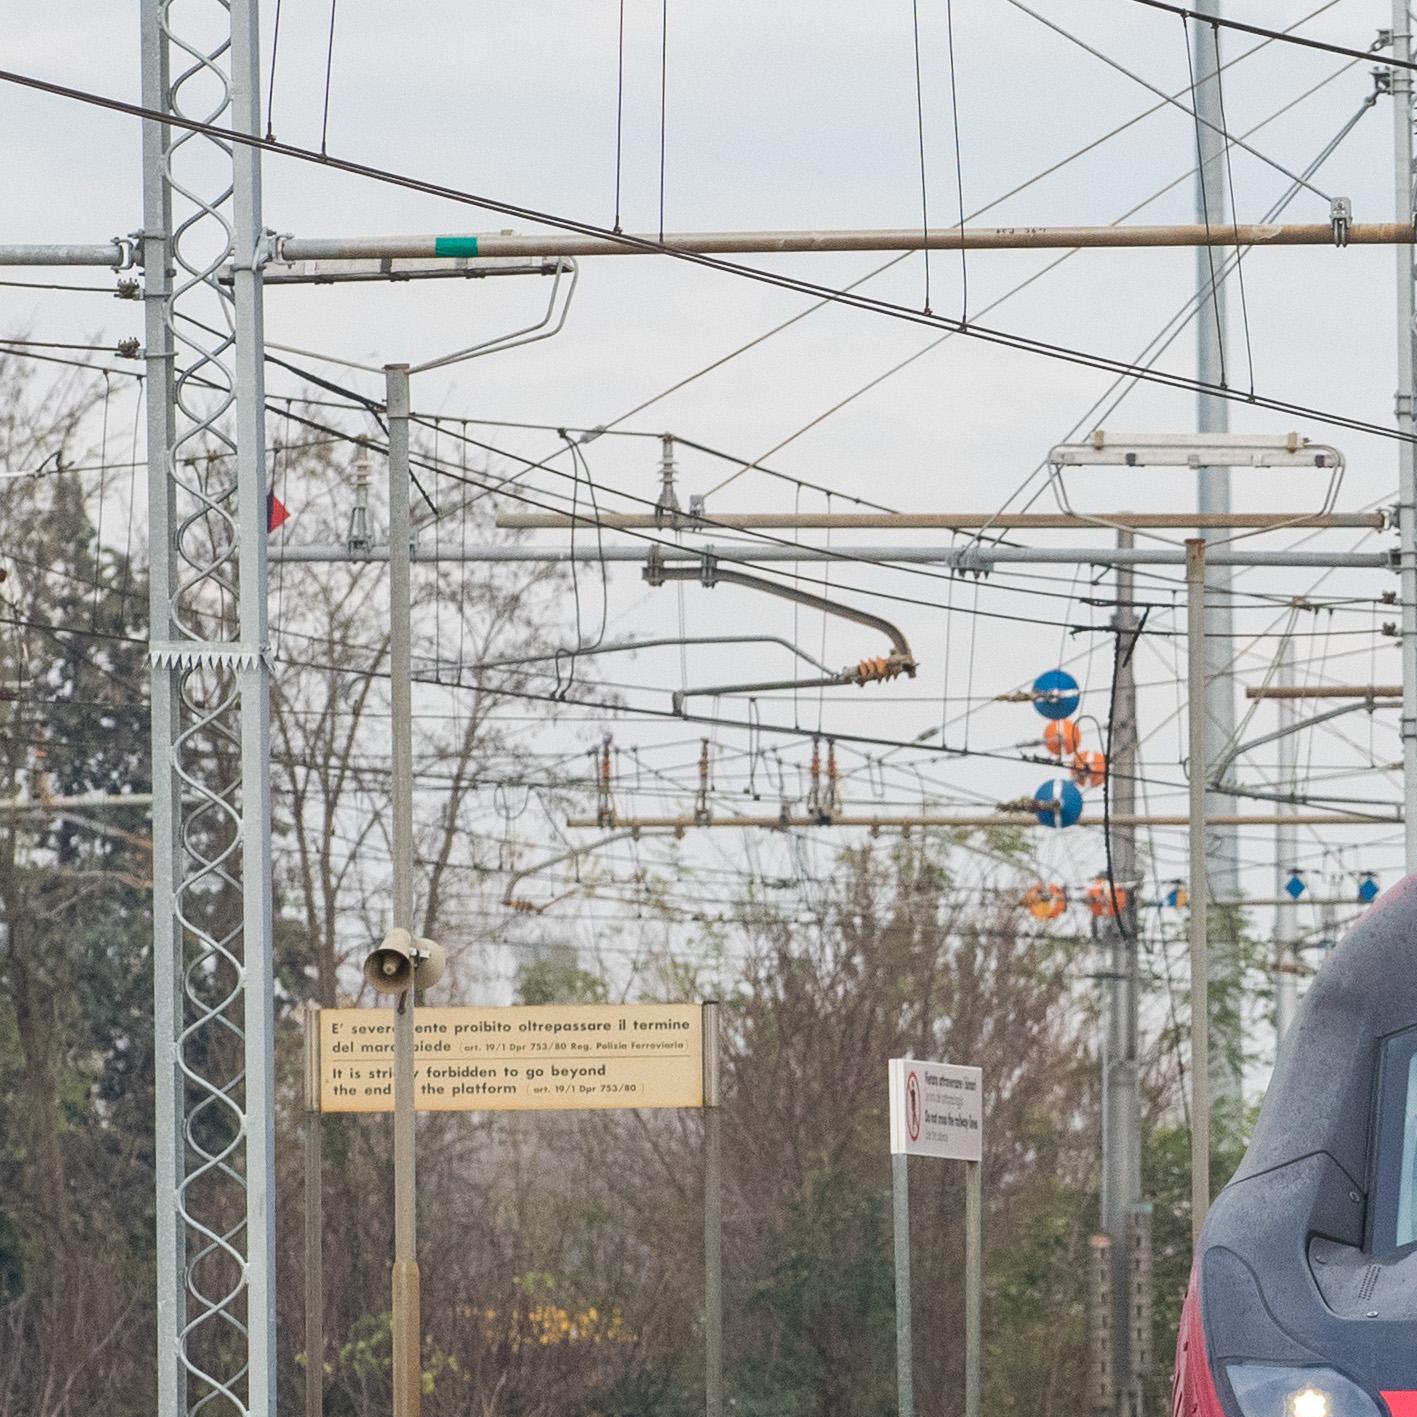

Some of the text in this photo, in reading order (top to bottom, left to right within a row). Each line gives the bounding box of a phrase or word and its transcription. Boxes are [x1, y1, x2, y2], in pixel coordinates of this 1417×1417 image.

[351, 1023, 448, 1034] severente
[454, 1021, 511, 1035] proibito
[519, 1019, 612, 1034] oltrepassare
[619, 1018, 626, 1031] il
[633, 1018, 690, 1031] termine
[332, 1041, 354, 1053] del
[361, 1040, 451, 1053] marciede
[486, 1043, 505, 1052] 19/1
[509, 1043, 526, 1052] Dpr
[530, 1042, 567, 1051] 753/80
[570, 1042, 592, 1052] Reg.
[332, 1068, 342, 1079] It
[349, 1067, 361, 1079] is
[427, 1066, 497, 1078] forbidden
[504, 1066, 518, 1077] to
[526, 1068, 544, 1080] go
[551, 1064, 606, 1079] beyond
[333, 1084, 357, 1096] the
[364, 1084, 392, 1096] end
[421, 1083, 445, 1095] the
[452, 1082, 517, 1097] platform
[555, 1084, 576, 1094] 19/1
[579, 1084, 597, 1095] Dpr
